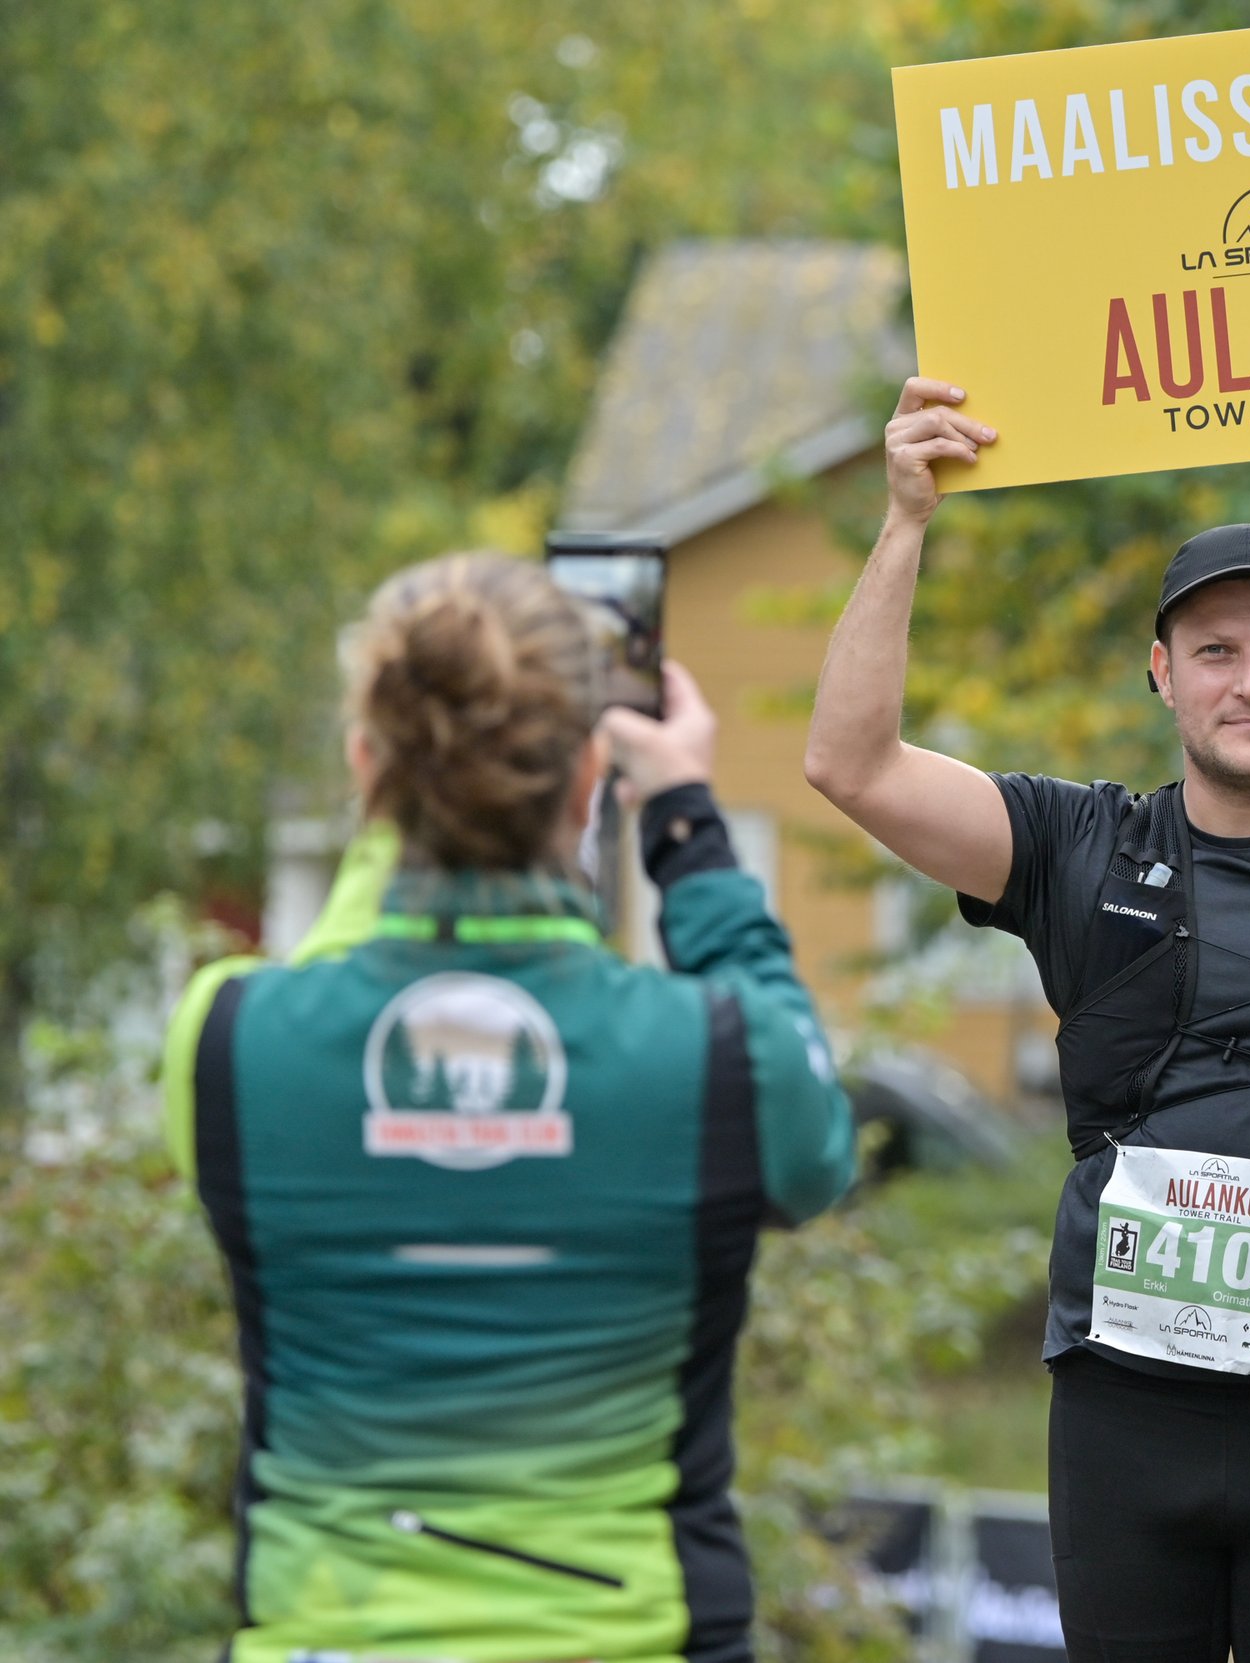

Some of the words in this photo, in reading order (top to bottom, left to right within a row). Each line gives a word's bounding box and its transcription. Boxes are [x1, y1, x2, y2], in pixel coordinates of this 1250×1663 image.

[1181, 251, 1217, 271] LA
[1102, 902, 1157, 921] SALOMON
[1200, 1171, 1240, 1182] SPORTIVA
[1179, 1209, 1210, 1219] TOWER
[1214, 1213, 1241, 1224] TRAIL
[1110, 1261, 1132, 1270] FINLAND
[1143, 1279, 1168, 1293] Erkki
[1109, 1300, 1123, 1308] Hydro
[1159, 1323, 1171, 1333] LA
[1173, 1326, 1228, 1343] SPORTIVA
[1176, 1350, 1215, 1362] HÄMEENLINNA
